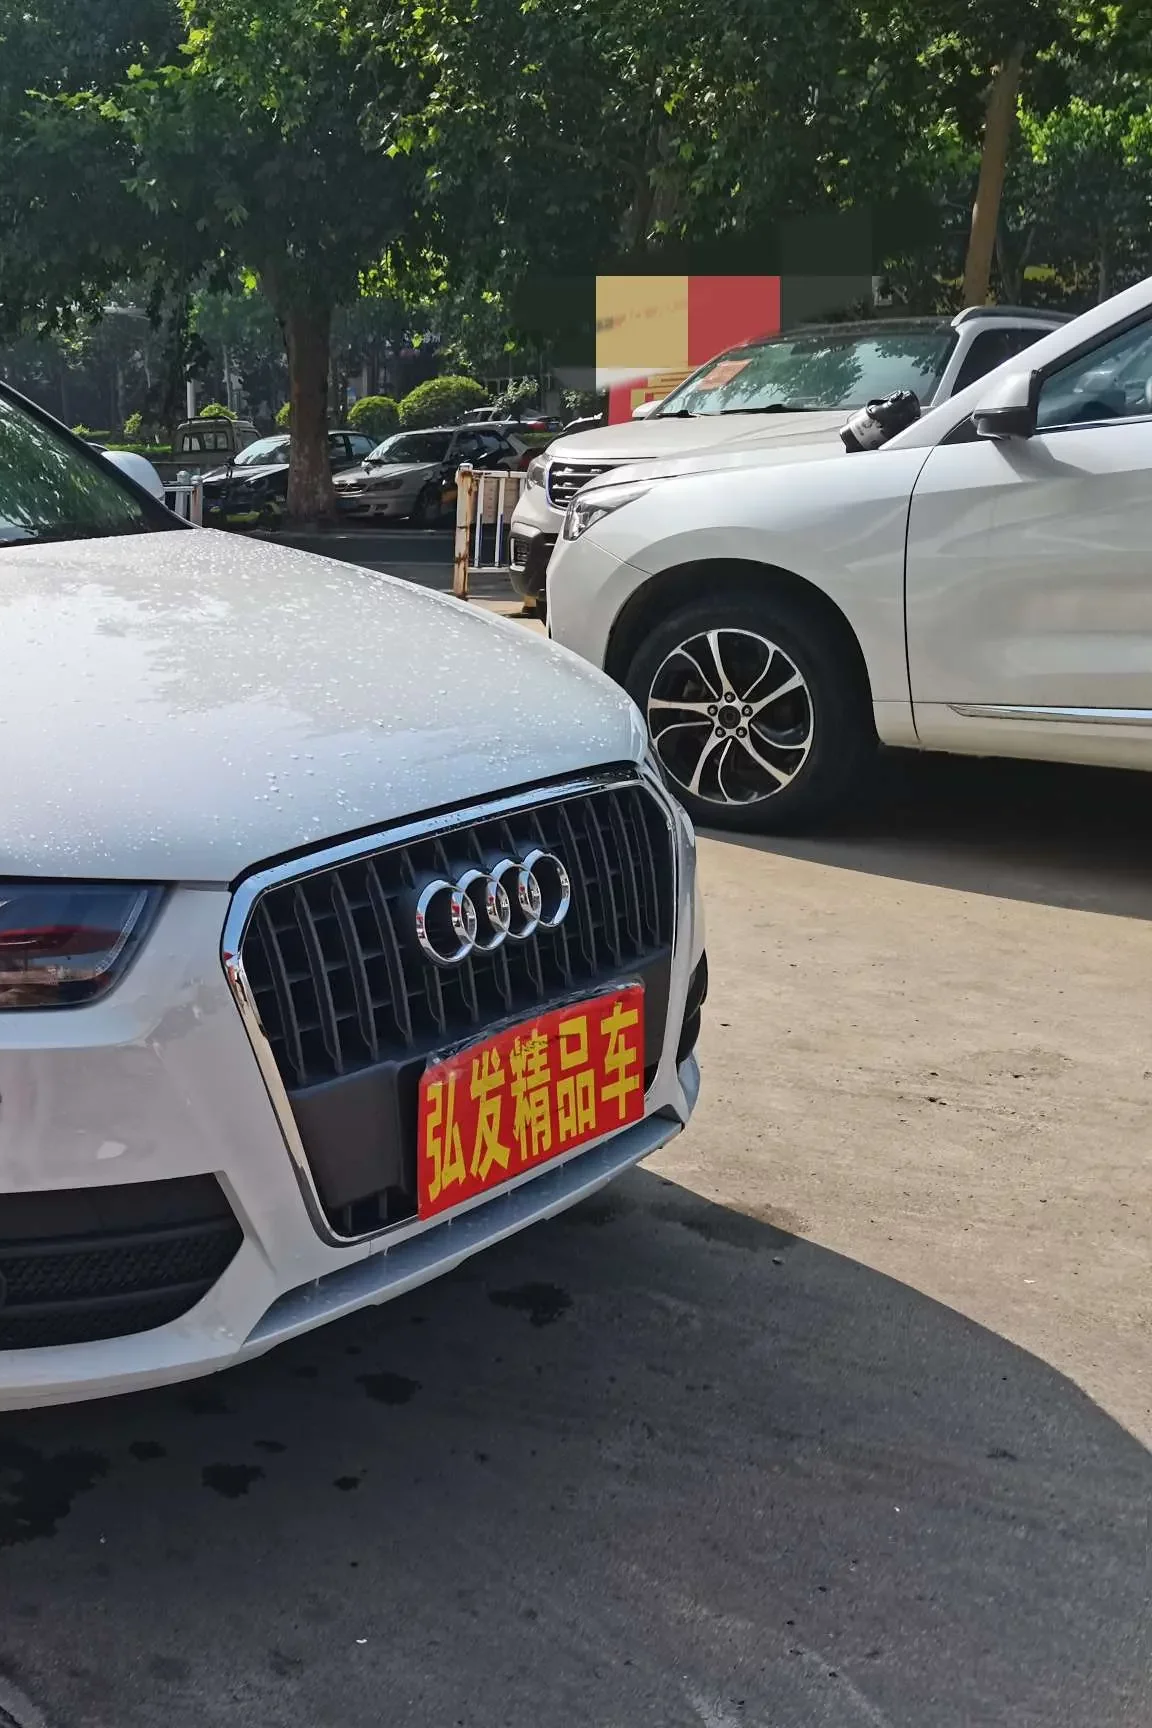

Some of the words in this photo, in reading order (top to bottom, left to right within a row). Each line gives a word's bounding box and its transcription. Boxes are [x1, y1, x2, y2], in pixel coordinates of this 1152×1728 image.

[426, 1001, 640, 1203] 弘发精品车
